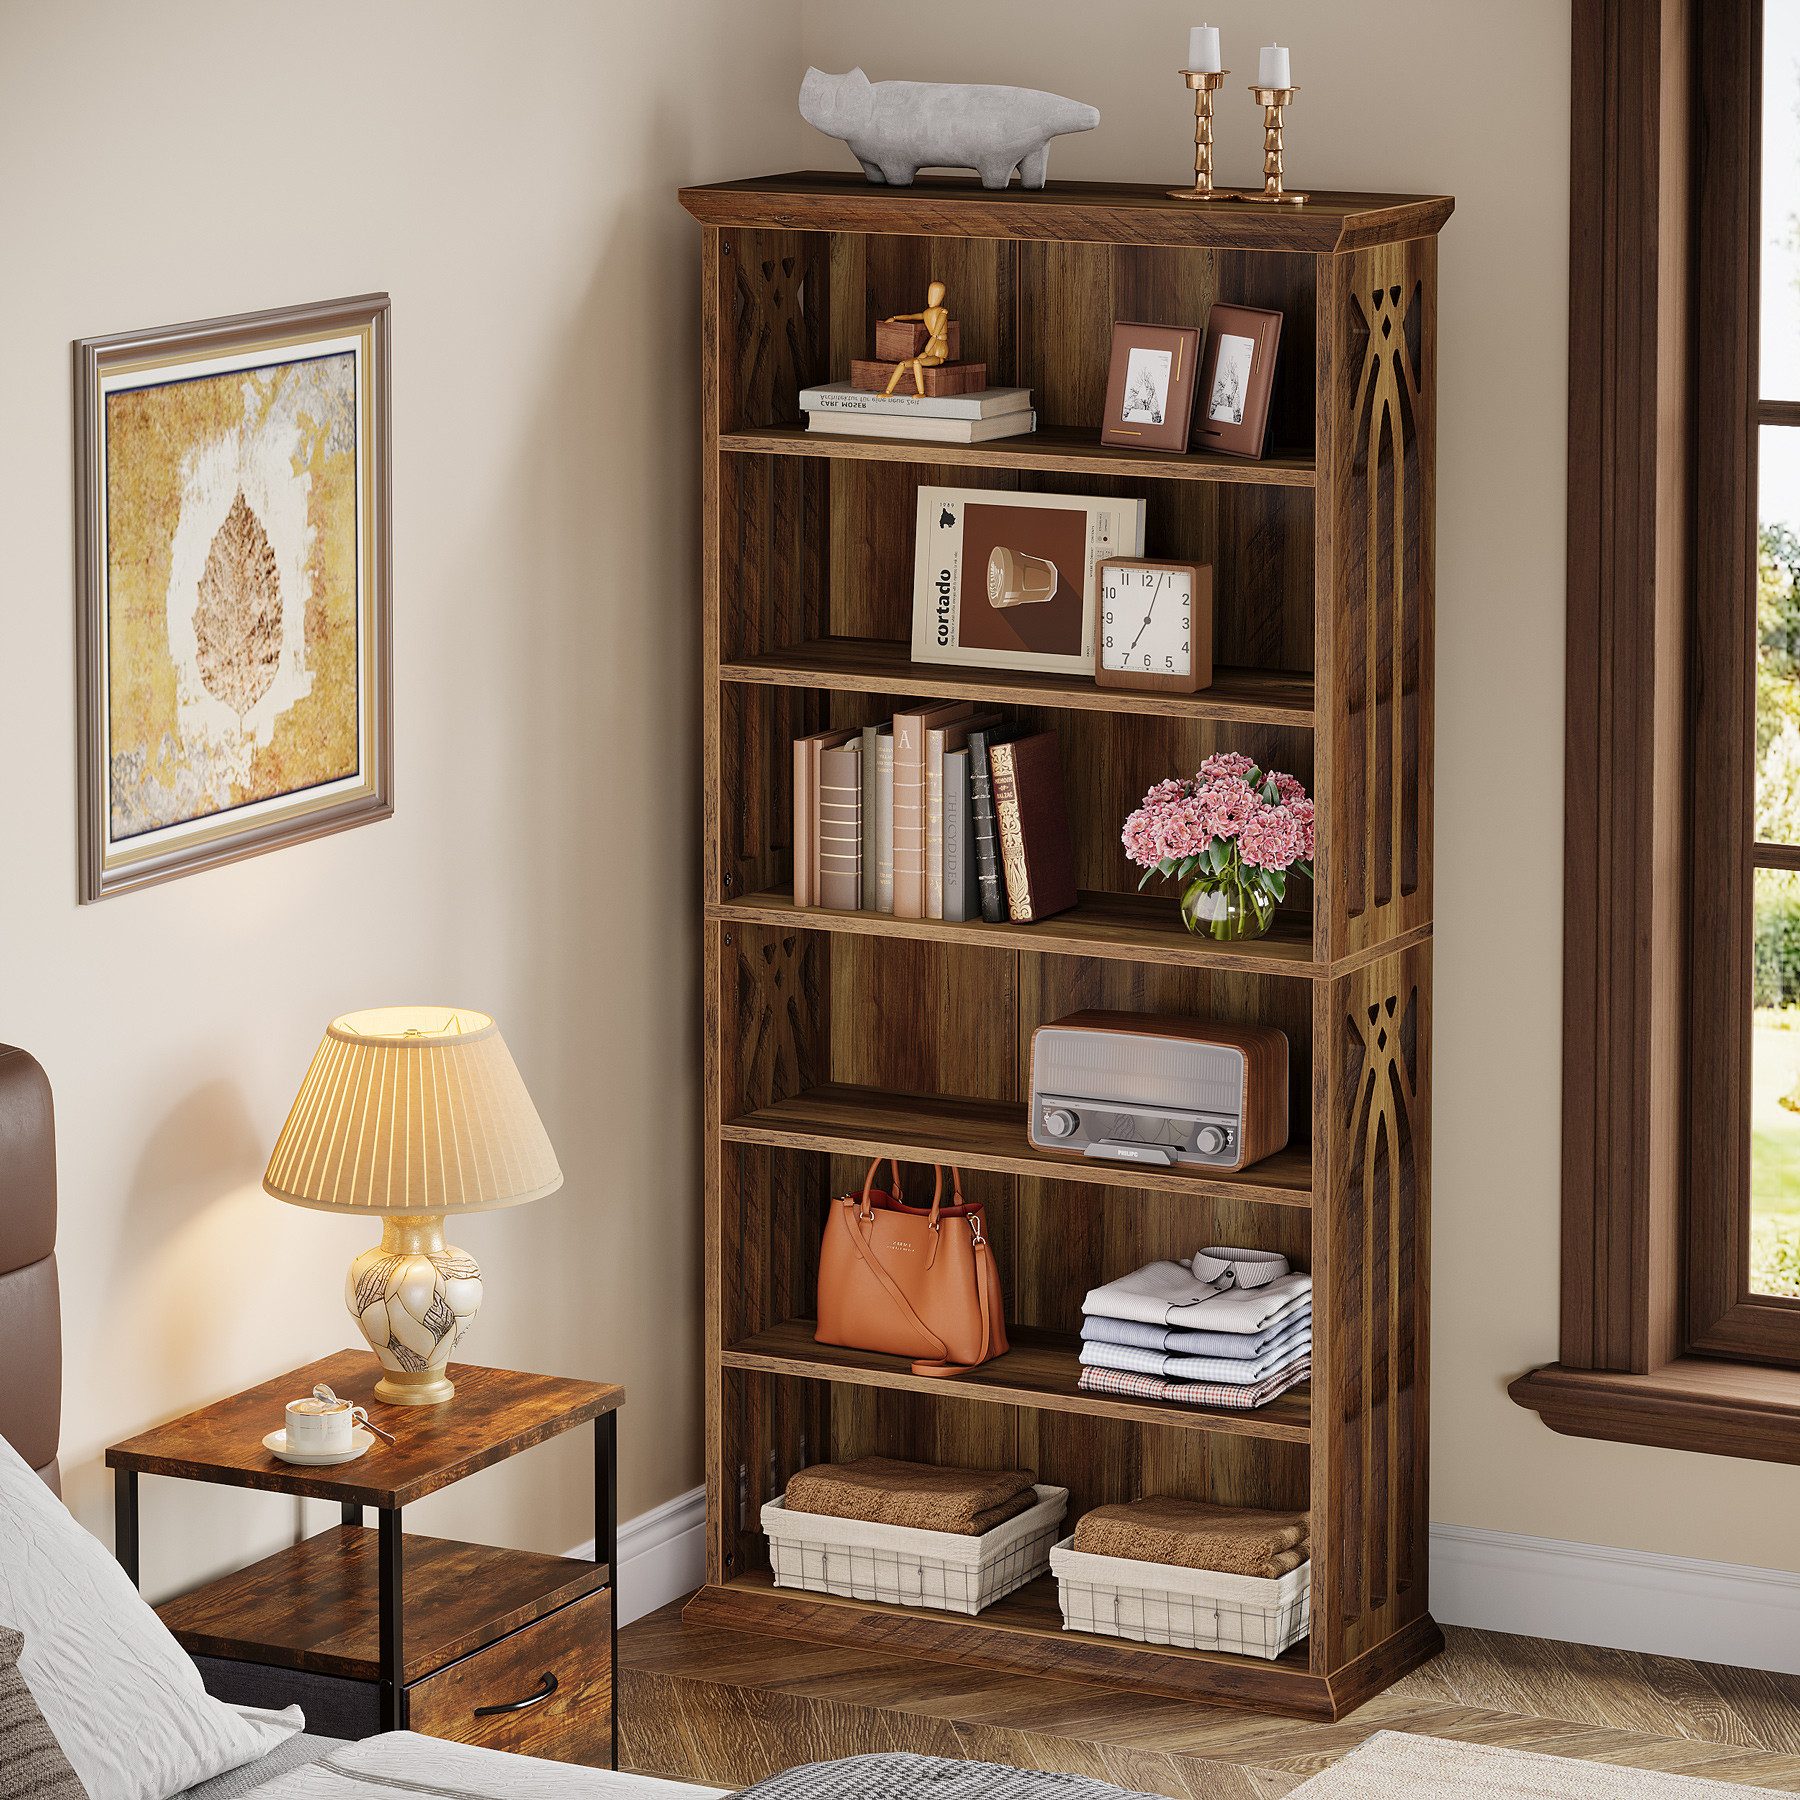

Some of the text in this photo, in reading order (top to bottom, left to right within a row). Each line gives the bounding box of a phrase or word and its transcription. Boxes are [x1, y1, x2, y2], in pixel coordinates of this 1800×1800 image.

[1121, 573, 1129, 586] 11
[1142, 574, 1154, 587] 12
[1105, 587, 1116, 599] 10
[1182, 594, 1190, 606] 2
[936, 570, 951, 646] cortado
[1106, 612, 1113, 624] 9
[1182, 618, 1190, 630] 3
[1106, 636, 1113, 648] 8
[1182, 642, 1189, 653] 4
[1122, 653, 1129, 665] 7
[1144, 654, 1151, 666] 6
[1165, 656, 1173, 668] 5
[898, 730, 912, 749] A
[947, 792, 957, 886] THUCYDIDES
